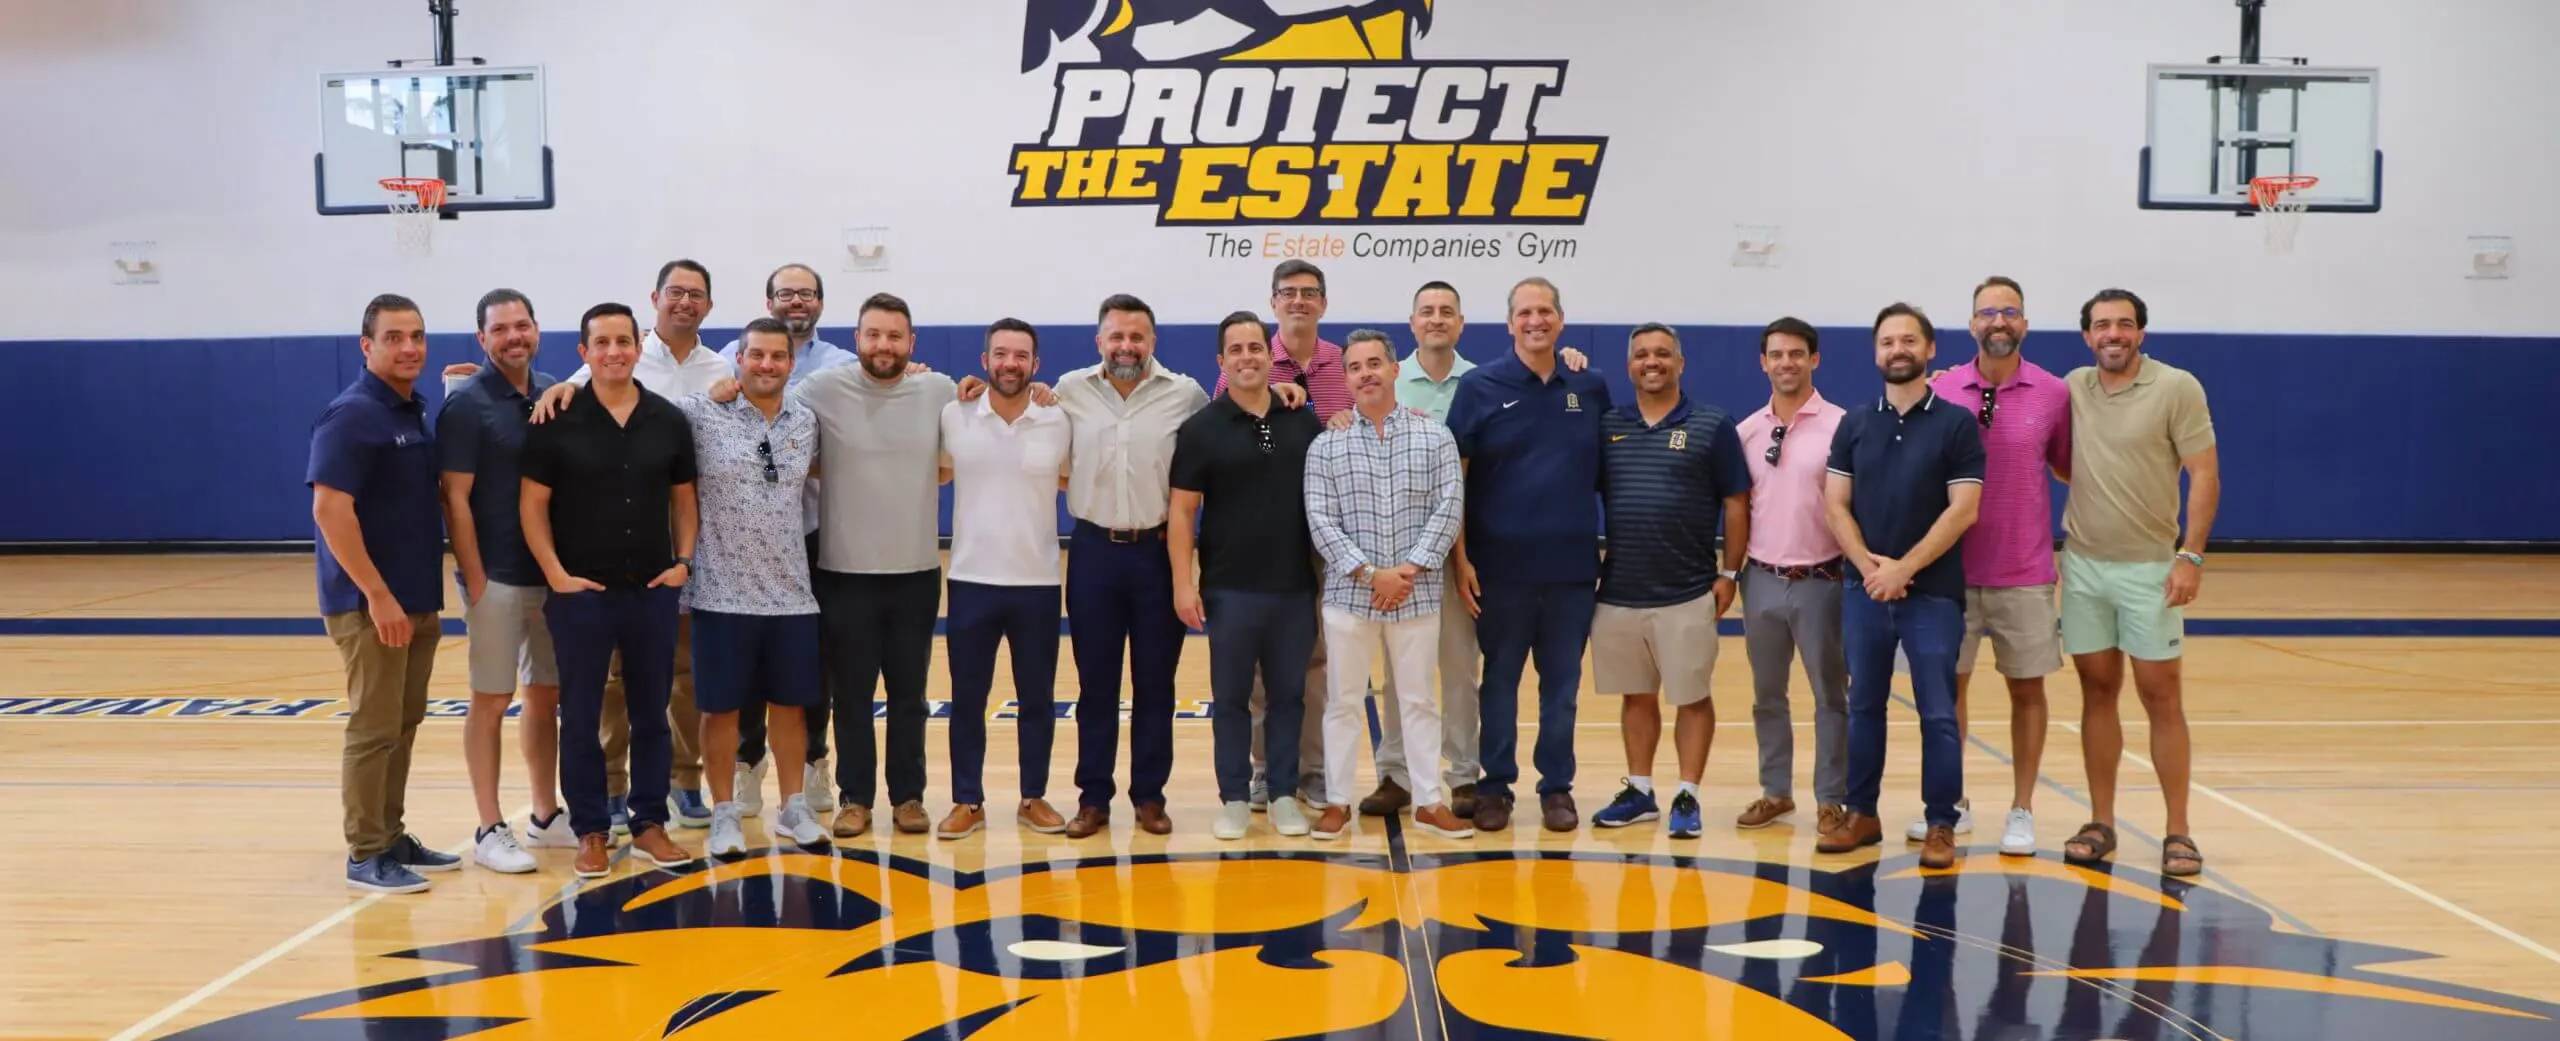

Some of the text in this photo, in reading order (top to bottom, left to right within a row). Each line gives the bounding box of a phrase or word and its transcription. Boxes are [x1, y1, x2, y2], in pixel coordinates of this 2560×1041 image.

[1046, 66, 1563, 147] PROTECT
[1015, 143, 1601, 220] THE ESTATE
[1205, 231, 1577, 264] The Estate Companies Gym
